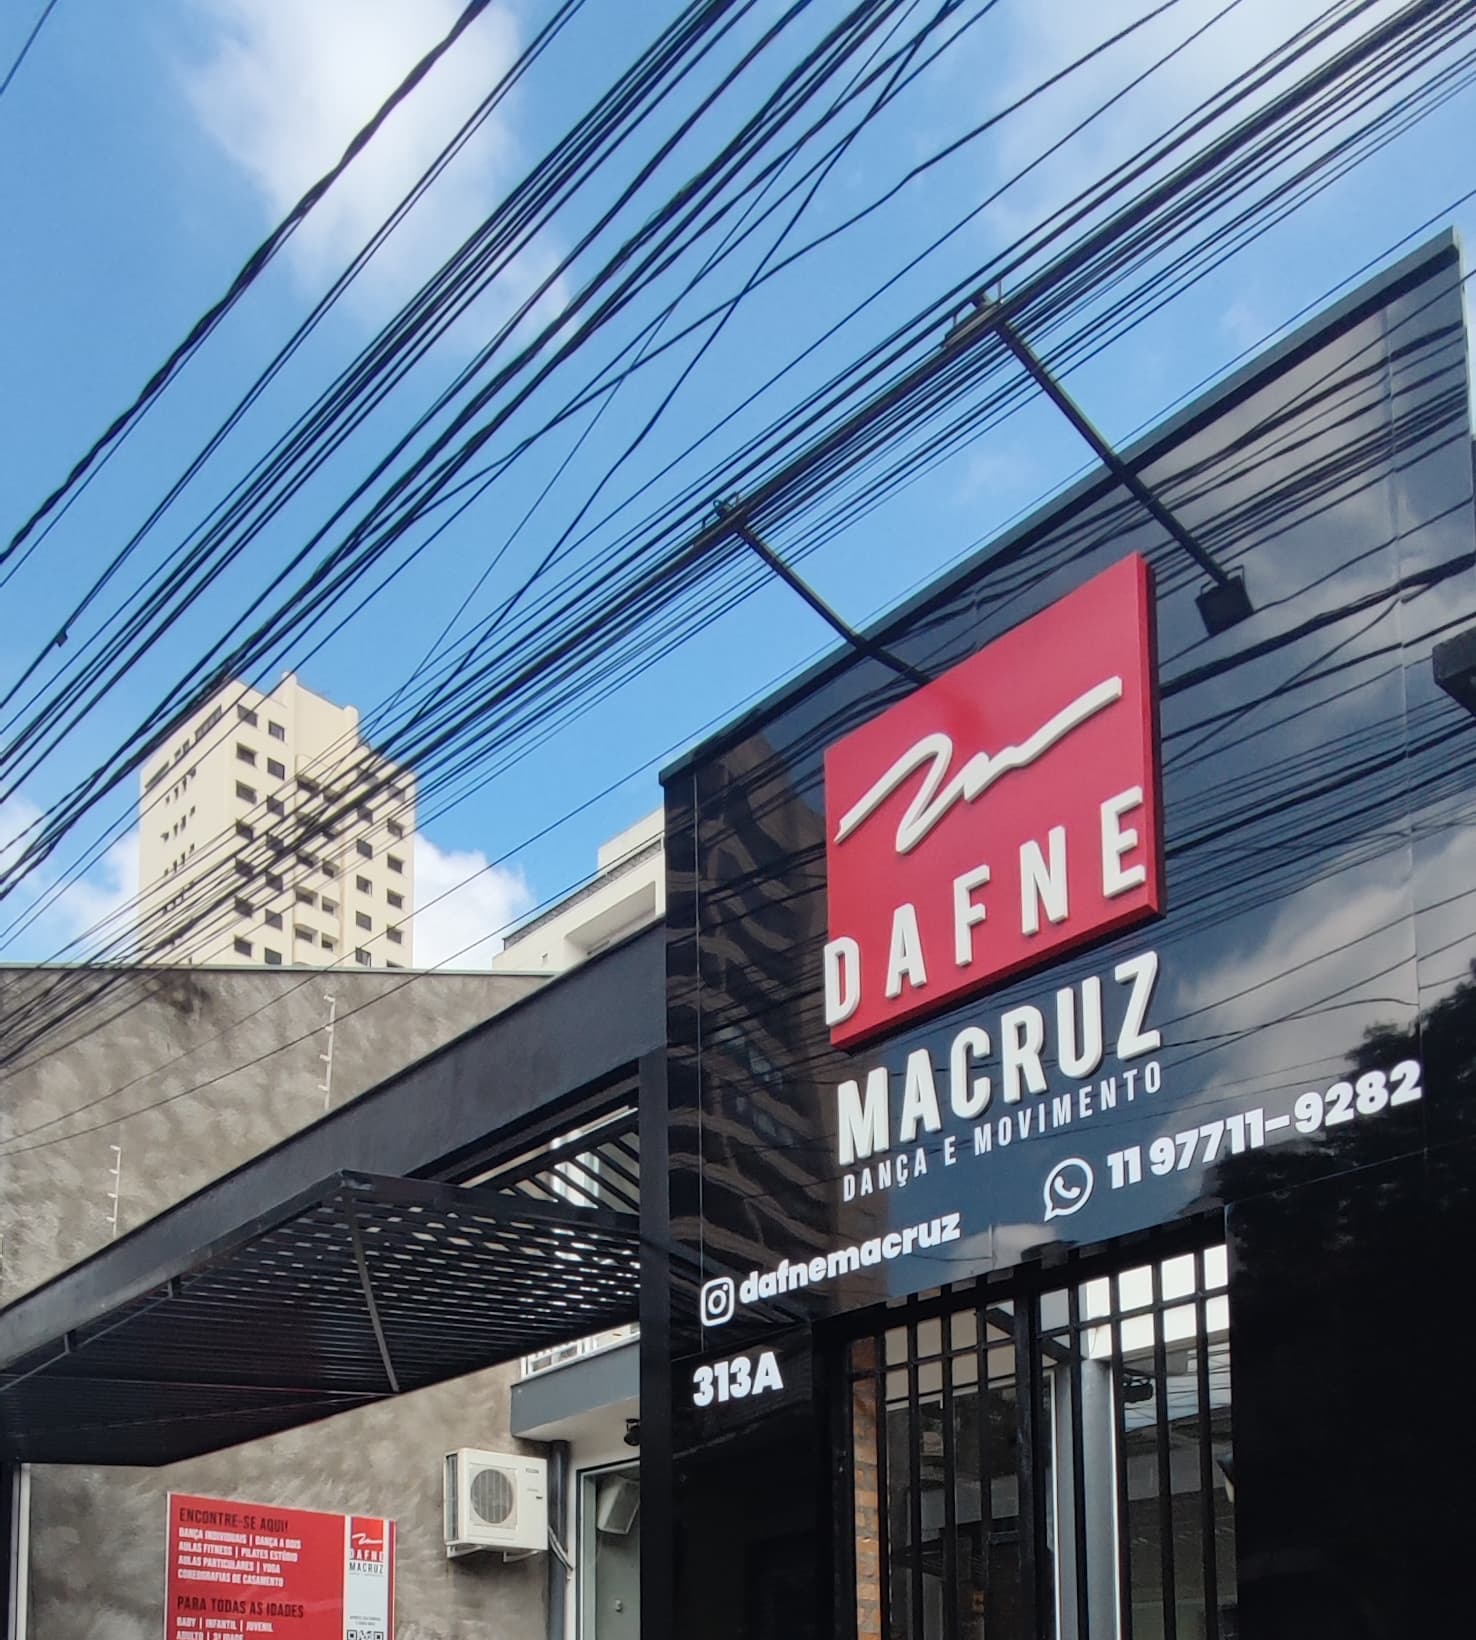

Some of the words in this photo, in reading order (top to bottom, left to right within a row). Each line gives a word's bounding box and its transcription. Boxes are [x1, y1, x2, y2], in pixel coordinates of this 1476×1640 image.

[824, 785, 1146, 1027] DAFNE
[837, 951, 1160, 1166] MACRUZ
[843, 1152, 928, 1202] DANÇA
[944, 1135, 957, 1167] E
[974, 1061, 1161, 1156] MOVIMENTO
[1107, 1145, 1143, 1190] 11
[1149, 1059, 1422, 1176] 97711-9282
[739, 1212, 961, 1304] dafnemacruz
[693, 1351, 784, 1407] 313A
[179, 1508, 256, 1530] ENCONTRE-SE
[260, 1518, 288, 1533] AQUI!
[178, 1596, 206, 1610] PARA
[212, 1599, 246, 1614] TODAS
[250, 1602, 263, 1615] AS
[267, 1603, 304, 1618] IDADES
[349, 1562, 384, 1574] MACRUZ
